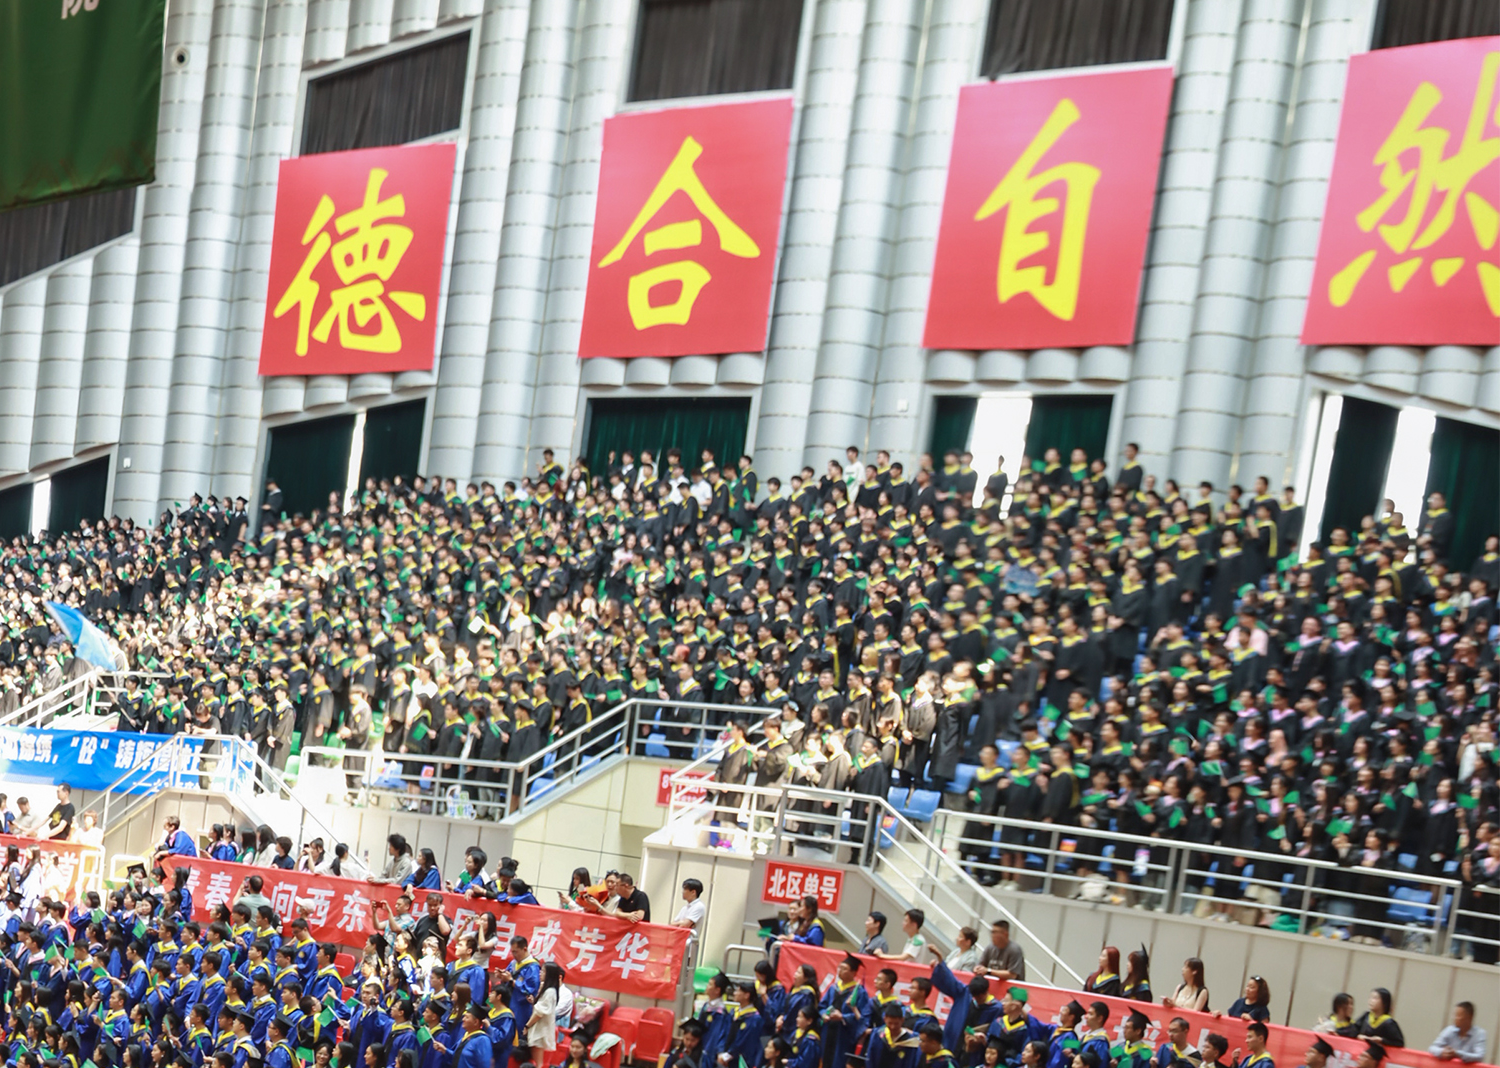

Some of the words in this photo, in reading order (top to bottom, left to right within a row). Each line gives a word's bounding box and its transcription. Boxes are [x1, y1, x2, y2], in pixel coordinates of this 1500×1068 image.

[273, 168, 426, 356] 德
[598, 135, 761, 331] 合
[975, 97, 1101, 323] 自
[767, 869, 838, 906] 北区单号
